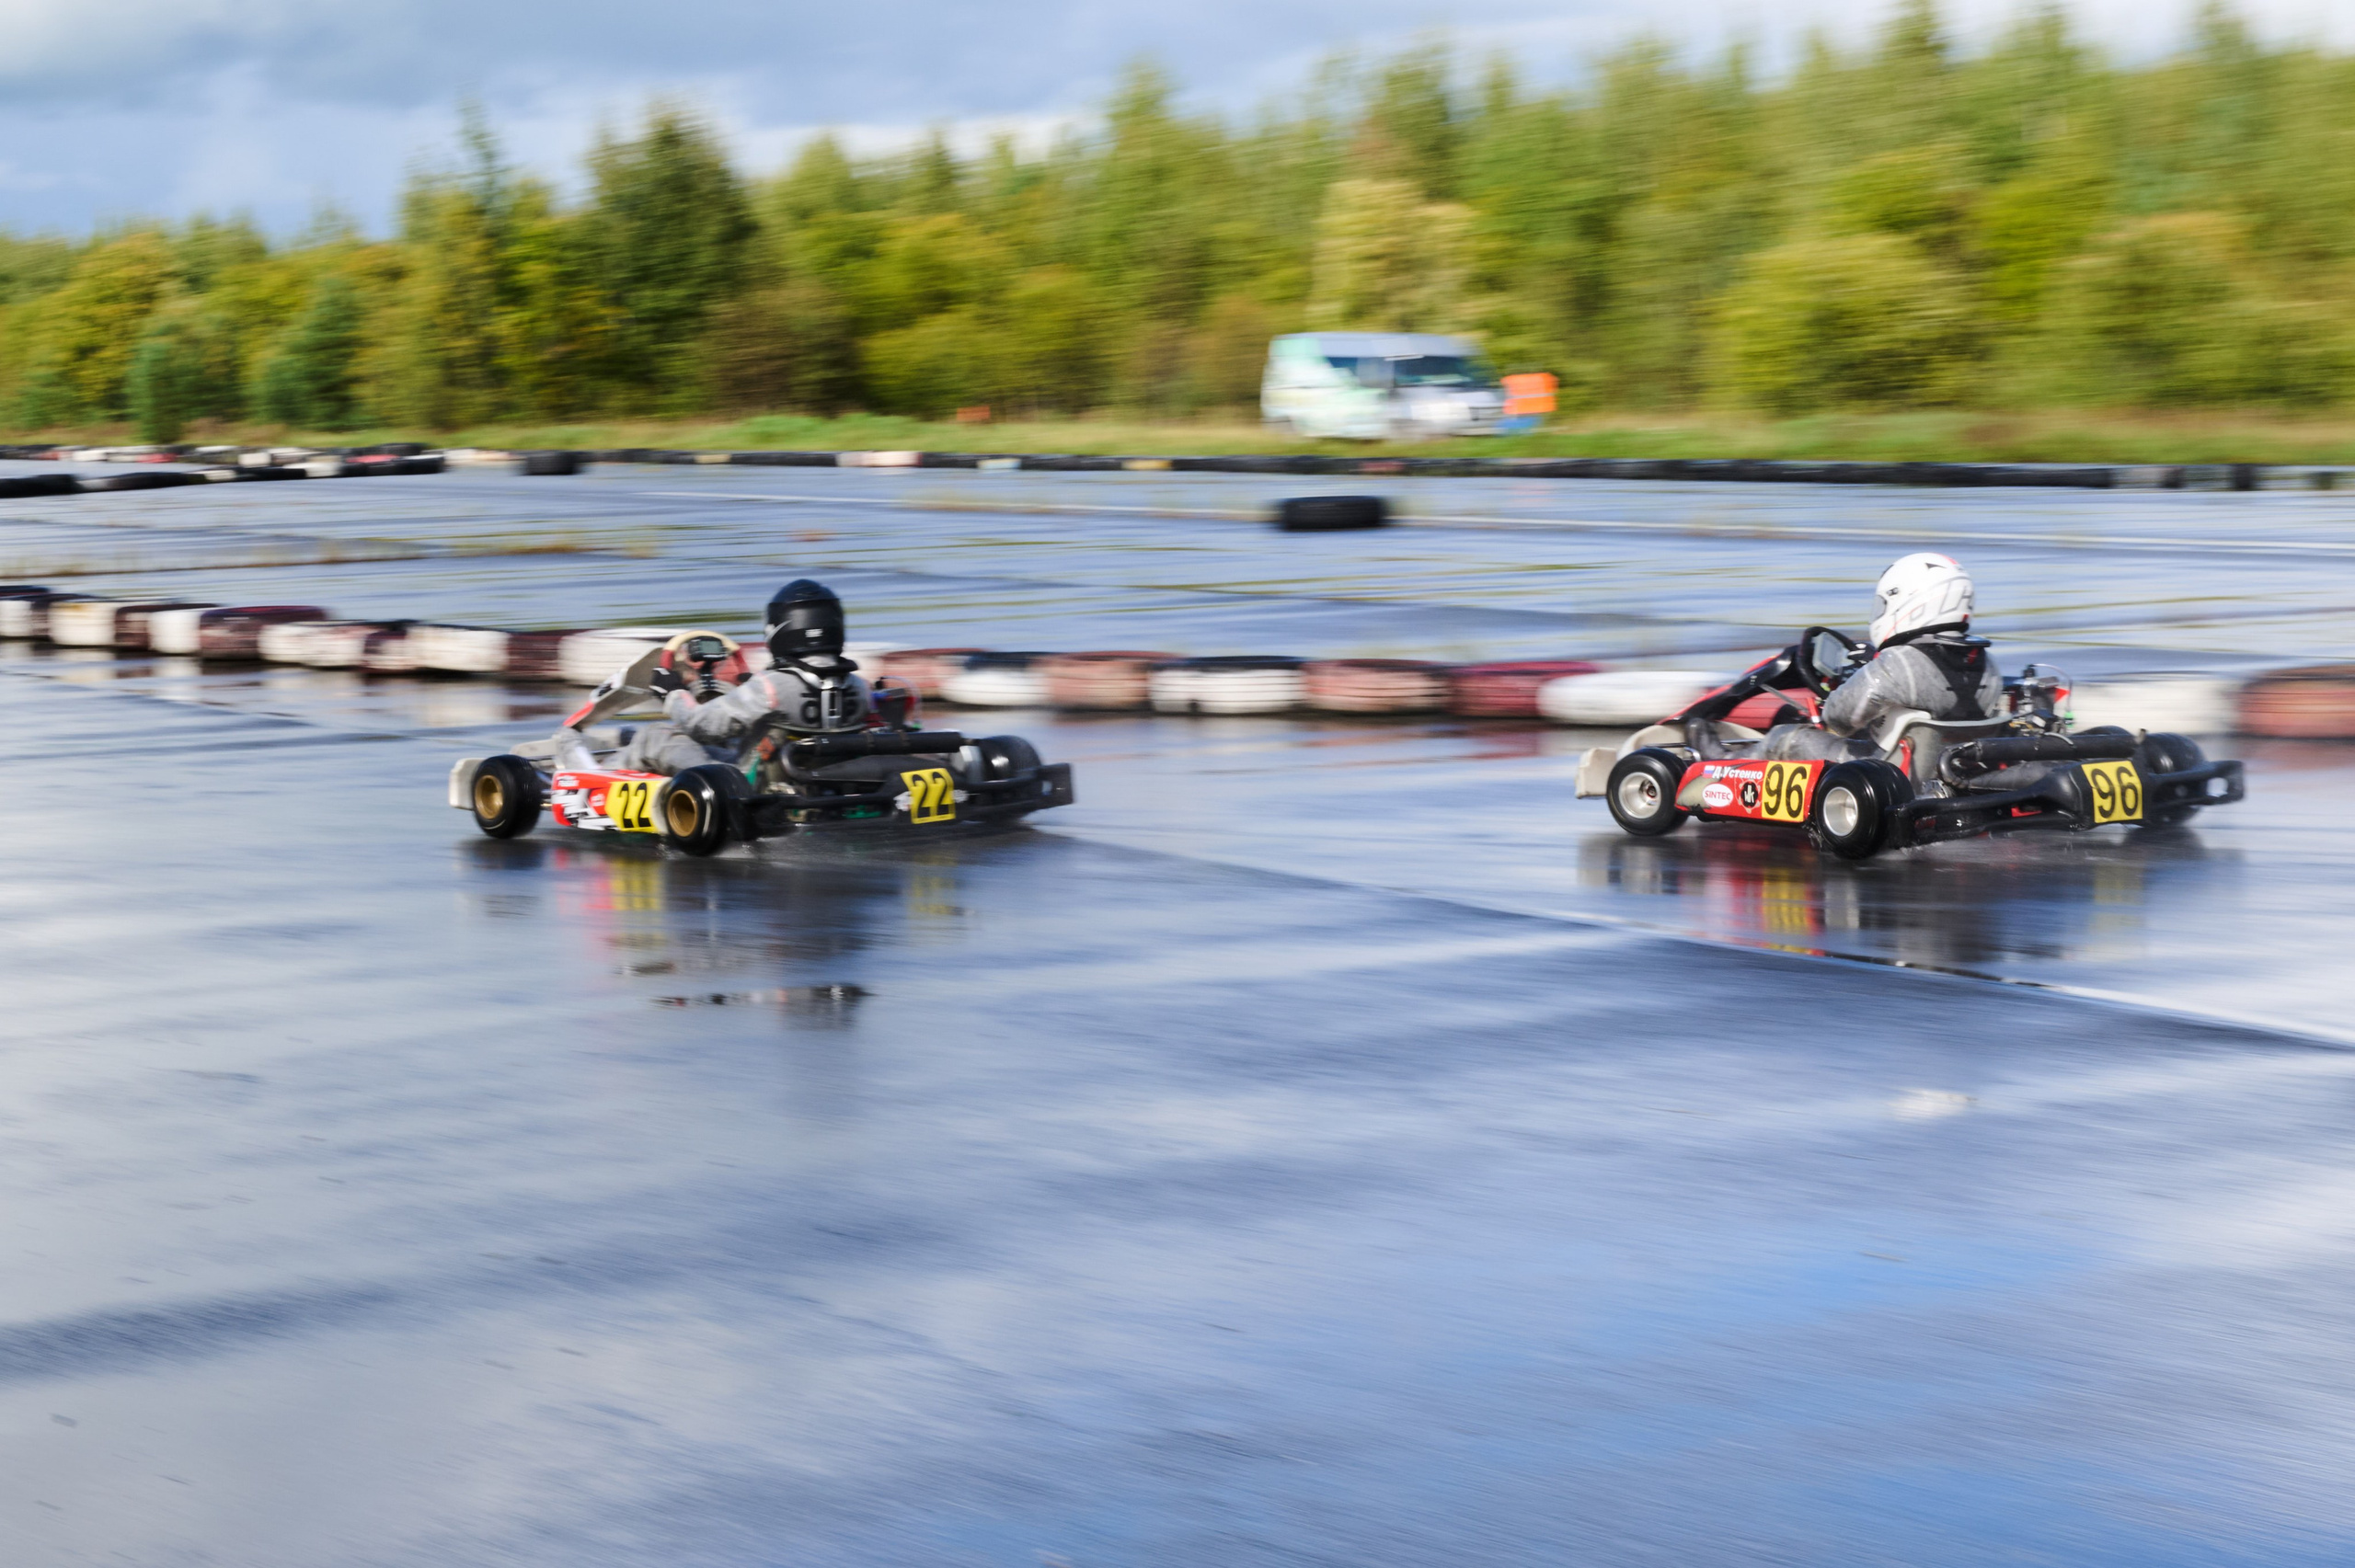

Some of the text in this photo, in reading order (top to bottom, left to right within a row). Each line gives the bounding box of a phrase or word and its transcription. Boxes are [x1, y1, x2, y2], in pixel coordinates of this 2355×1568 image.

[617, 782, 652, 829] 22
[913, 771, 949, 818] 22
[1705, 790, 1731, 801] SINTEC
[1763, 763, 1808, 818] 96
[2091, 765, 2139, 818] 96
